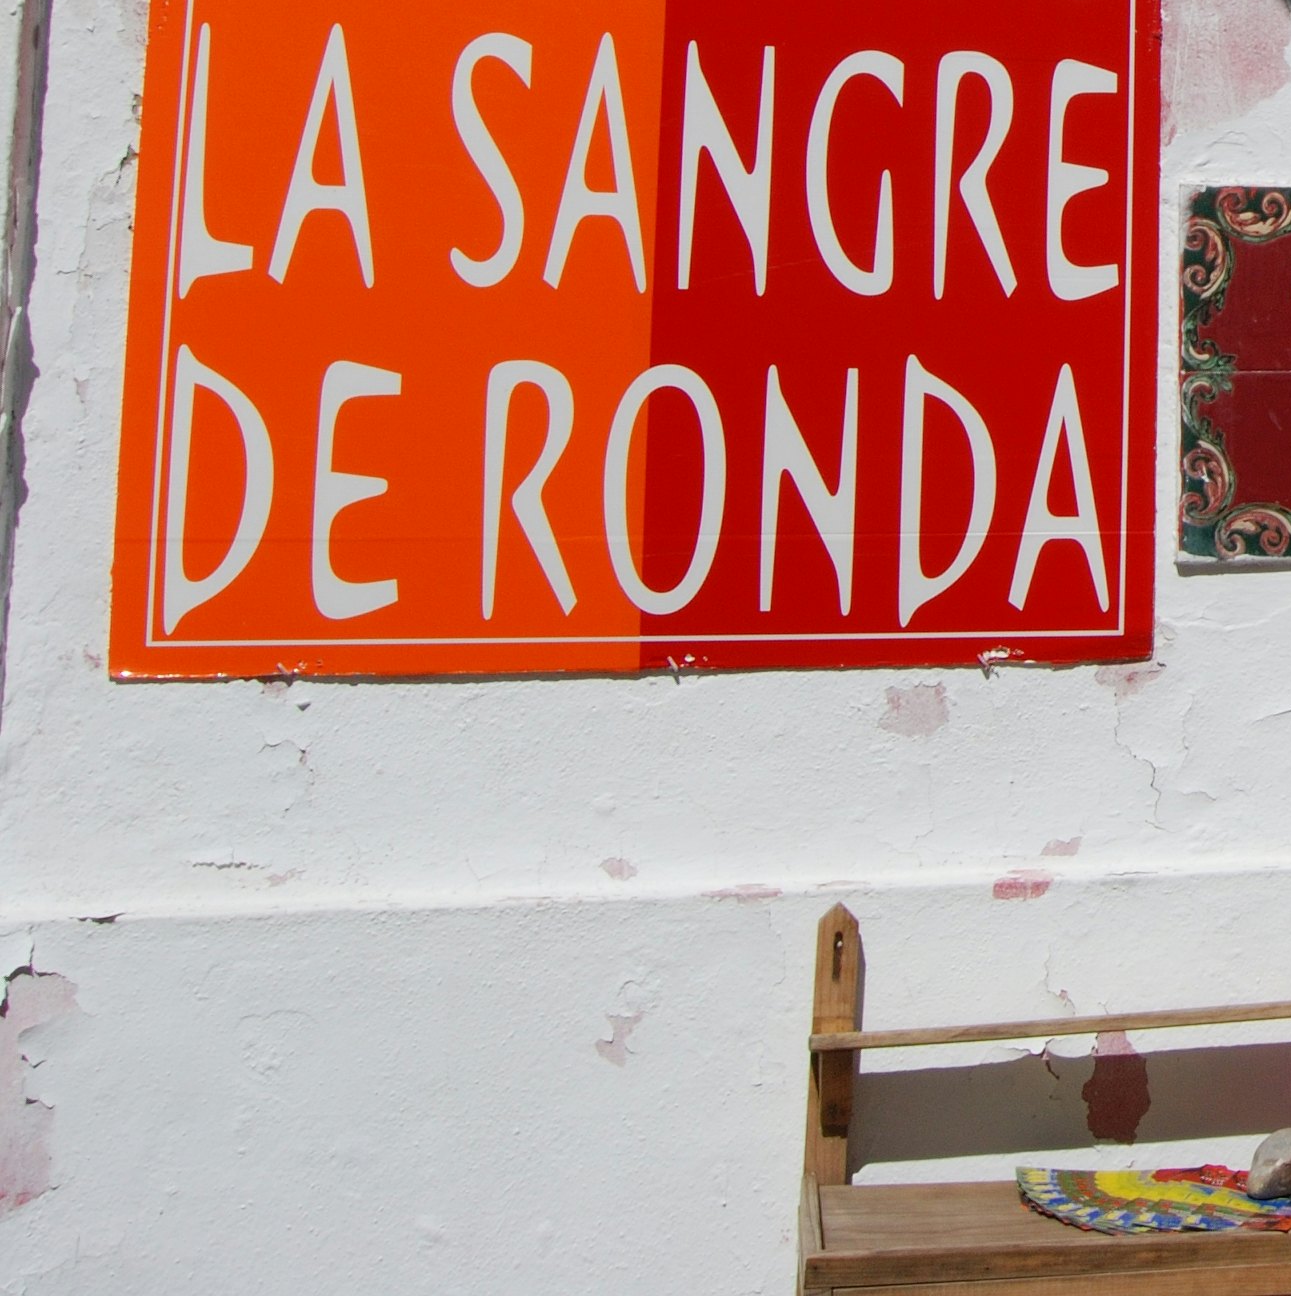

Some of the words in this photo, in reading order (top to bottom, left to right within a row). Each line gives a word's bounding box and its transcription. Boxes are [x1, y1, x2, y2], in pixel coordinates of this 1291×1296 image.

[178, 22, 375, 299] LA
[450, 31, 1120, 301] SANGRE
[163, 343, 402, 636] DE
[480, 353, 1110, 629] RONDA
